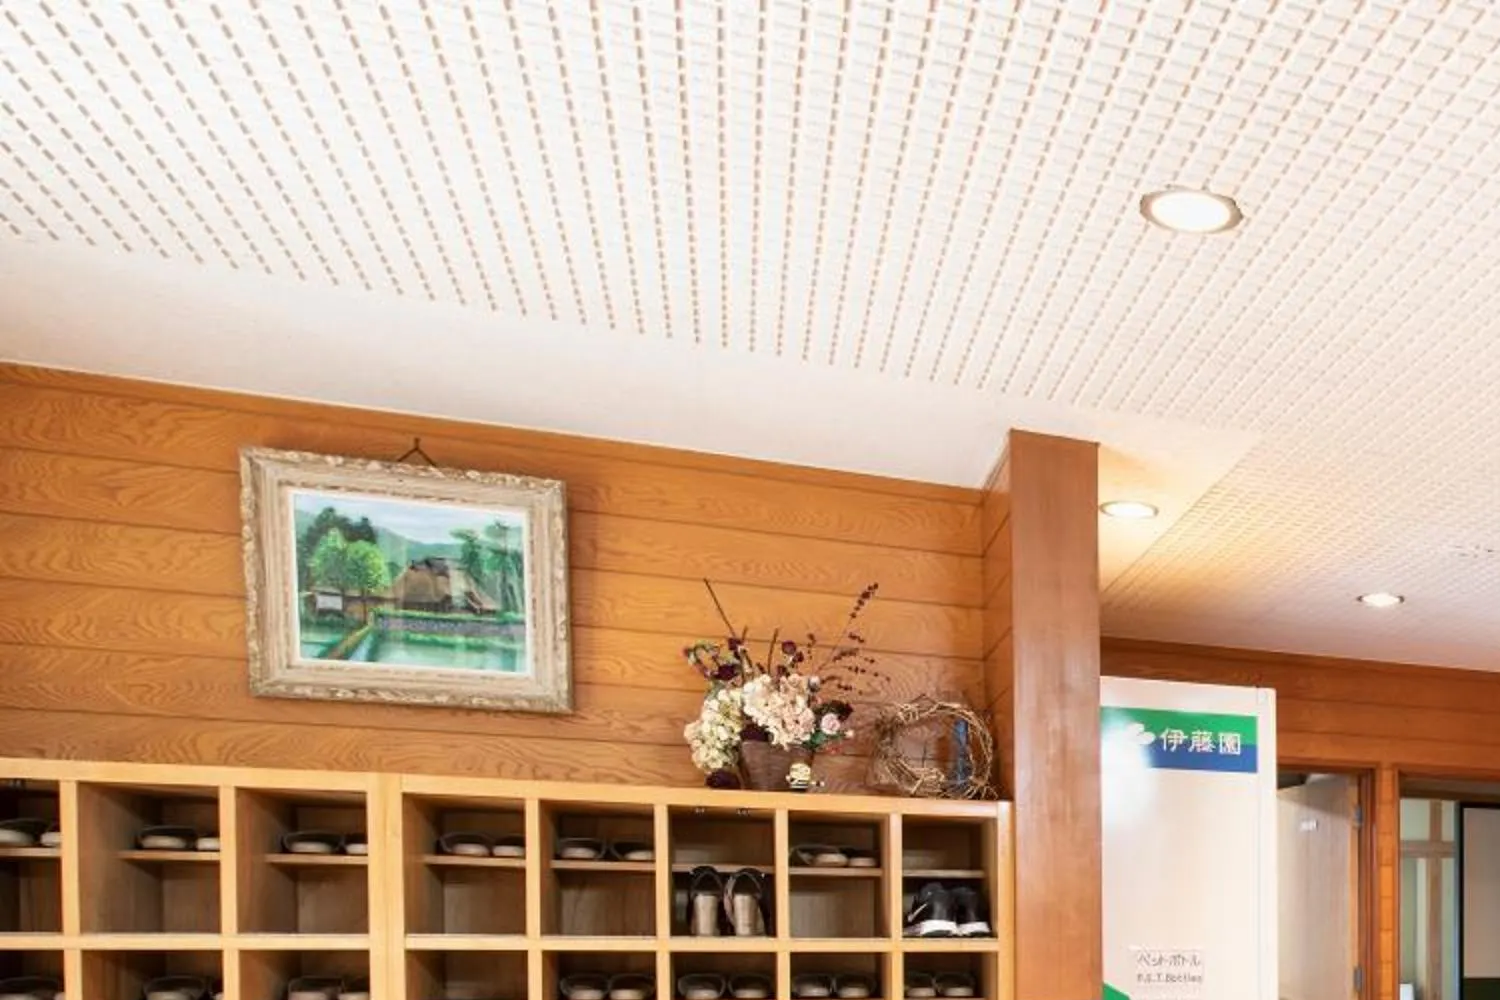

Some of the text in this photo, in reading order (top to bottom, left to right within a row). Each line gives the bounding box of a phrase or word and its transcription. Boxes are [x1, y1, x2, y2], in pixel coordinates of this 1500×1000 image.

[1161, 728, 1241, 755] 伊藤園
[1137, 952, 1201, 966] ペットボトル
